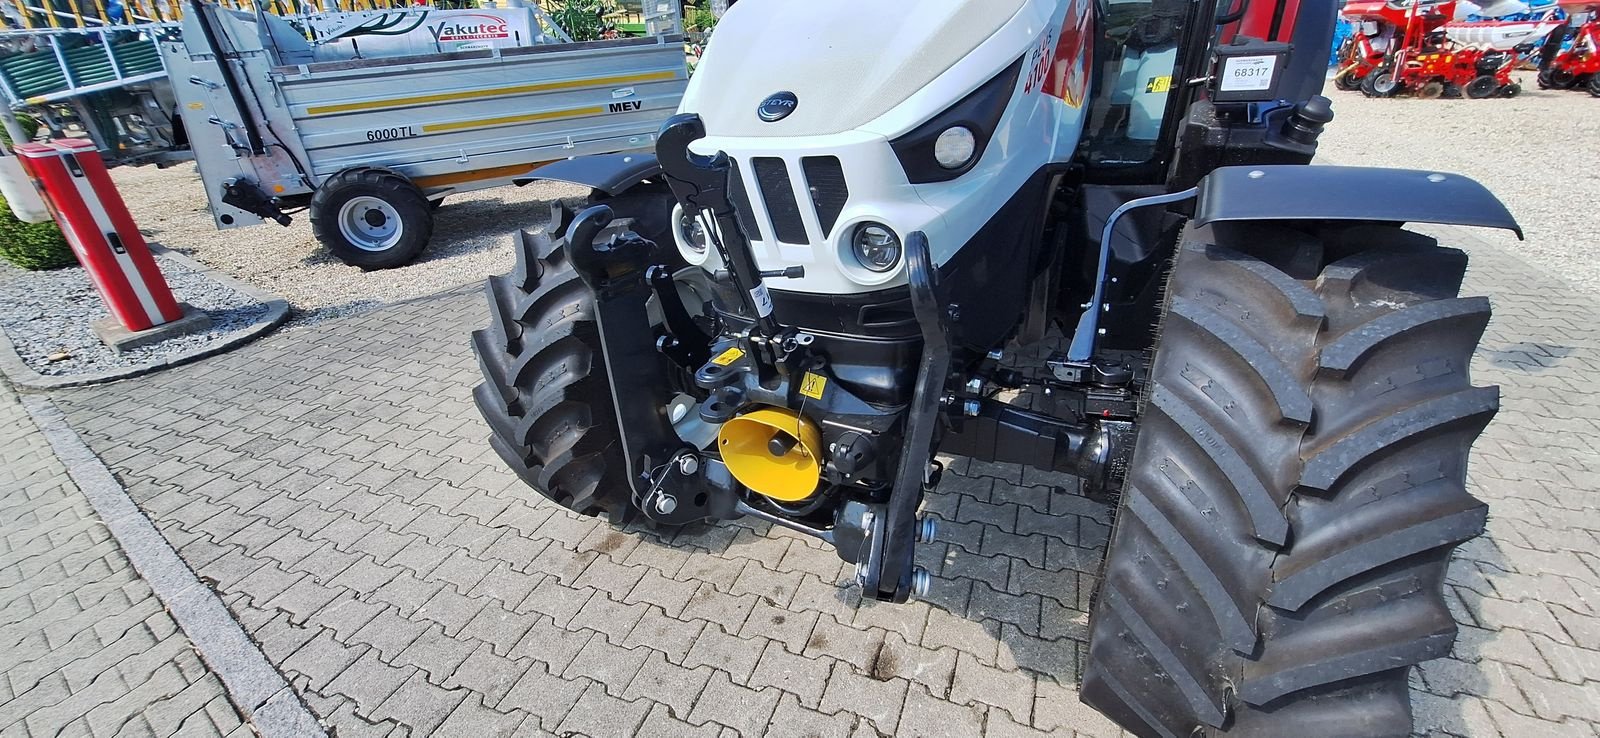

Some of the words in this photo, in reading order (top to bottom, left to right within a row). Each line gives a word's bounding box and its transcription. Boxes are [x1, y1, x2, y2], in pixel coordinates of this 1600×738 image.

[427, 21, 508, 53] Vakutec
[1030, 28, 1053, 67] PLUS
[1023, 47, 1050, 95] 4100
[1234, 67, 1268, 77] 68317
[608, 100, 642, 113] MEV
[760, 99, 794, 108] STEYR
